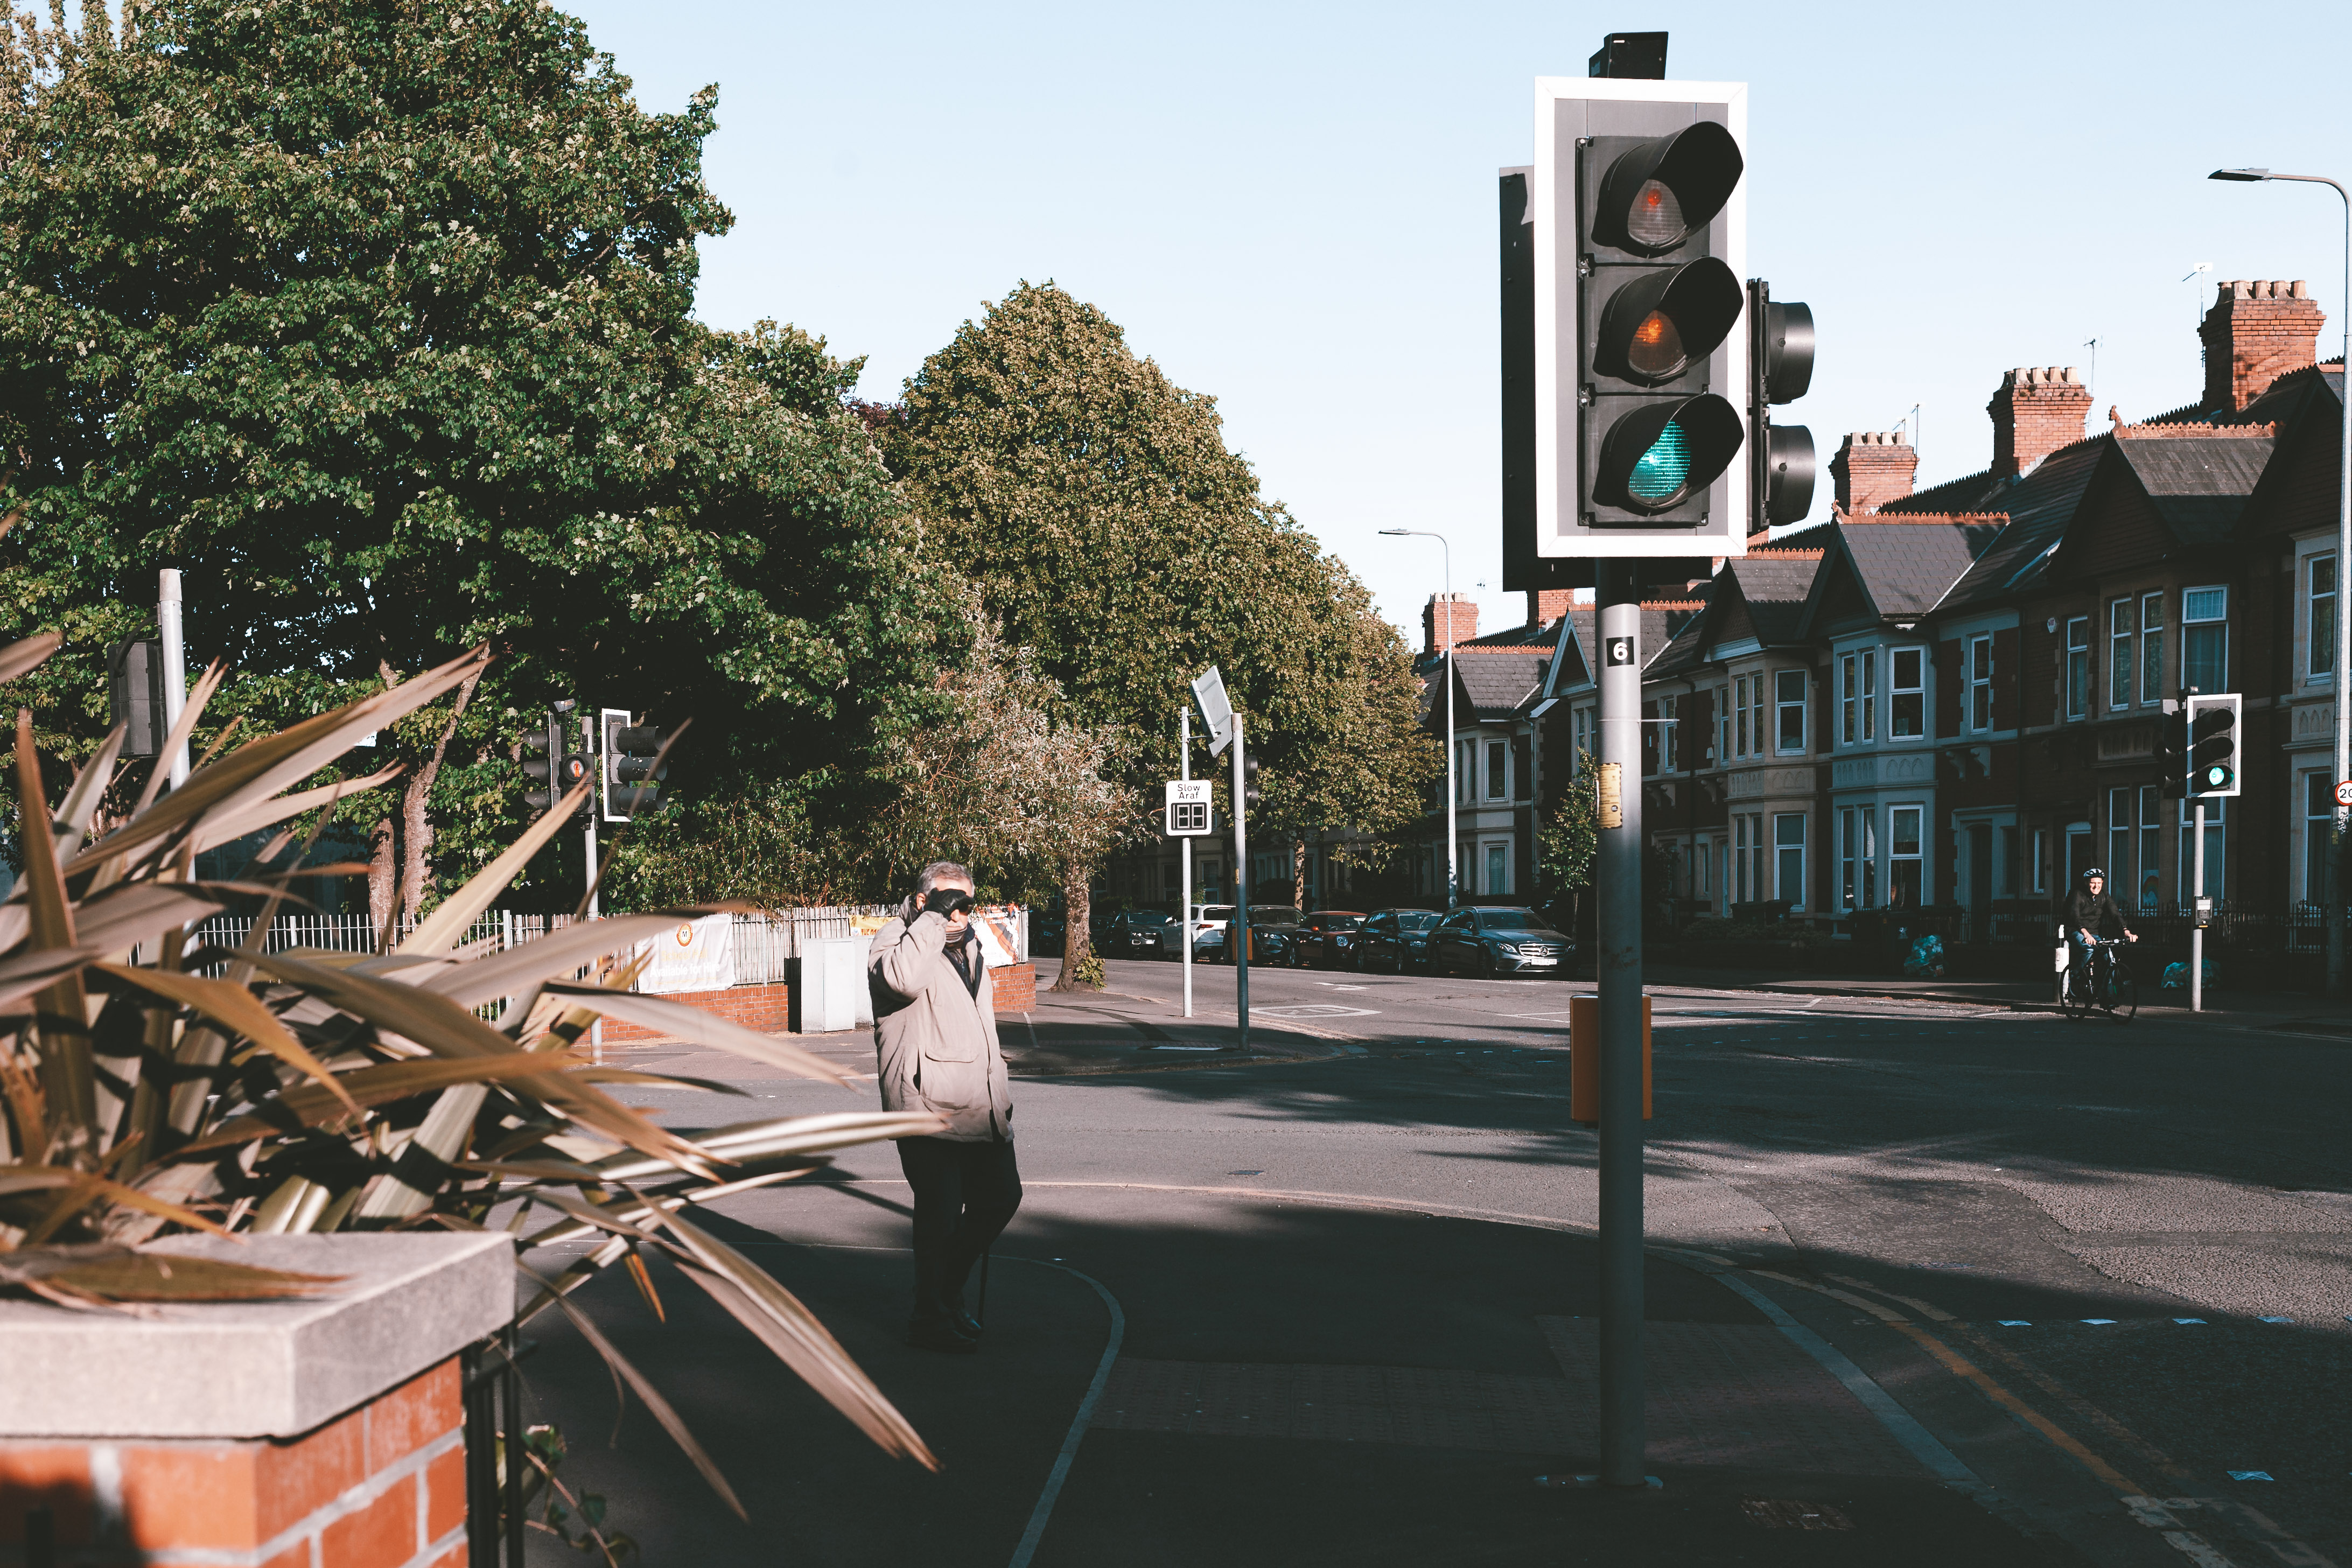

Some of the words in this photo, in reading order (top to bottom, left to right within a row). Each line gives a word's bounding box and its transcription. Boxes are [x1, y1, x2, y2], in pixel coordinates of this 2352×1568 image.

[1614, 642, 1628, 660] 6
[1177, 783, 1200, 792] Slow
[661, 949, 690, 962] School
[692, 947, 708, 960] Hall
[649, 964, 688, 977] Available
[689, 963, 701, 975] for
[703, 962, 720, 973] Hire
